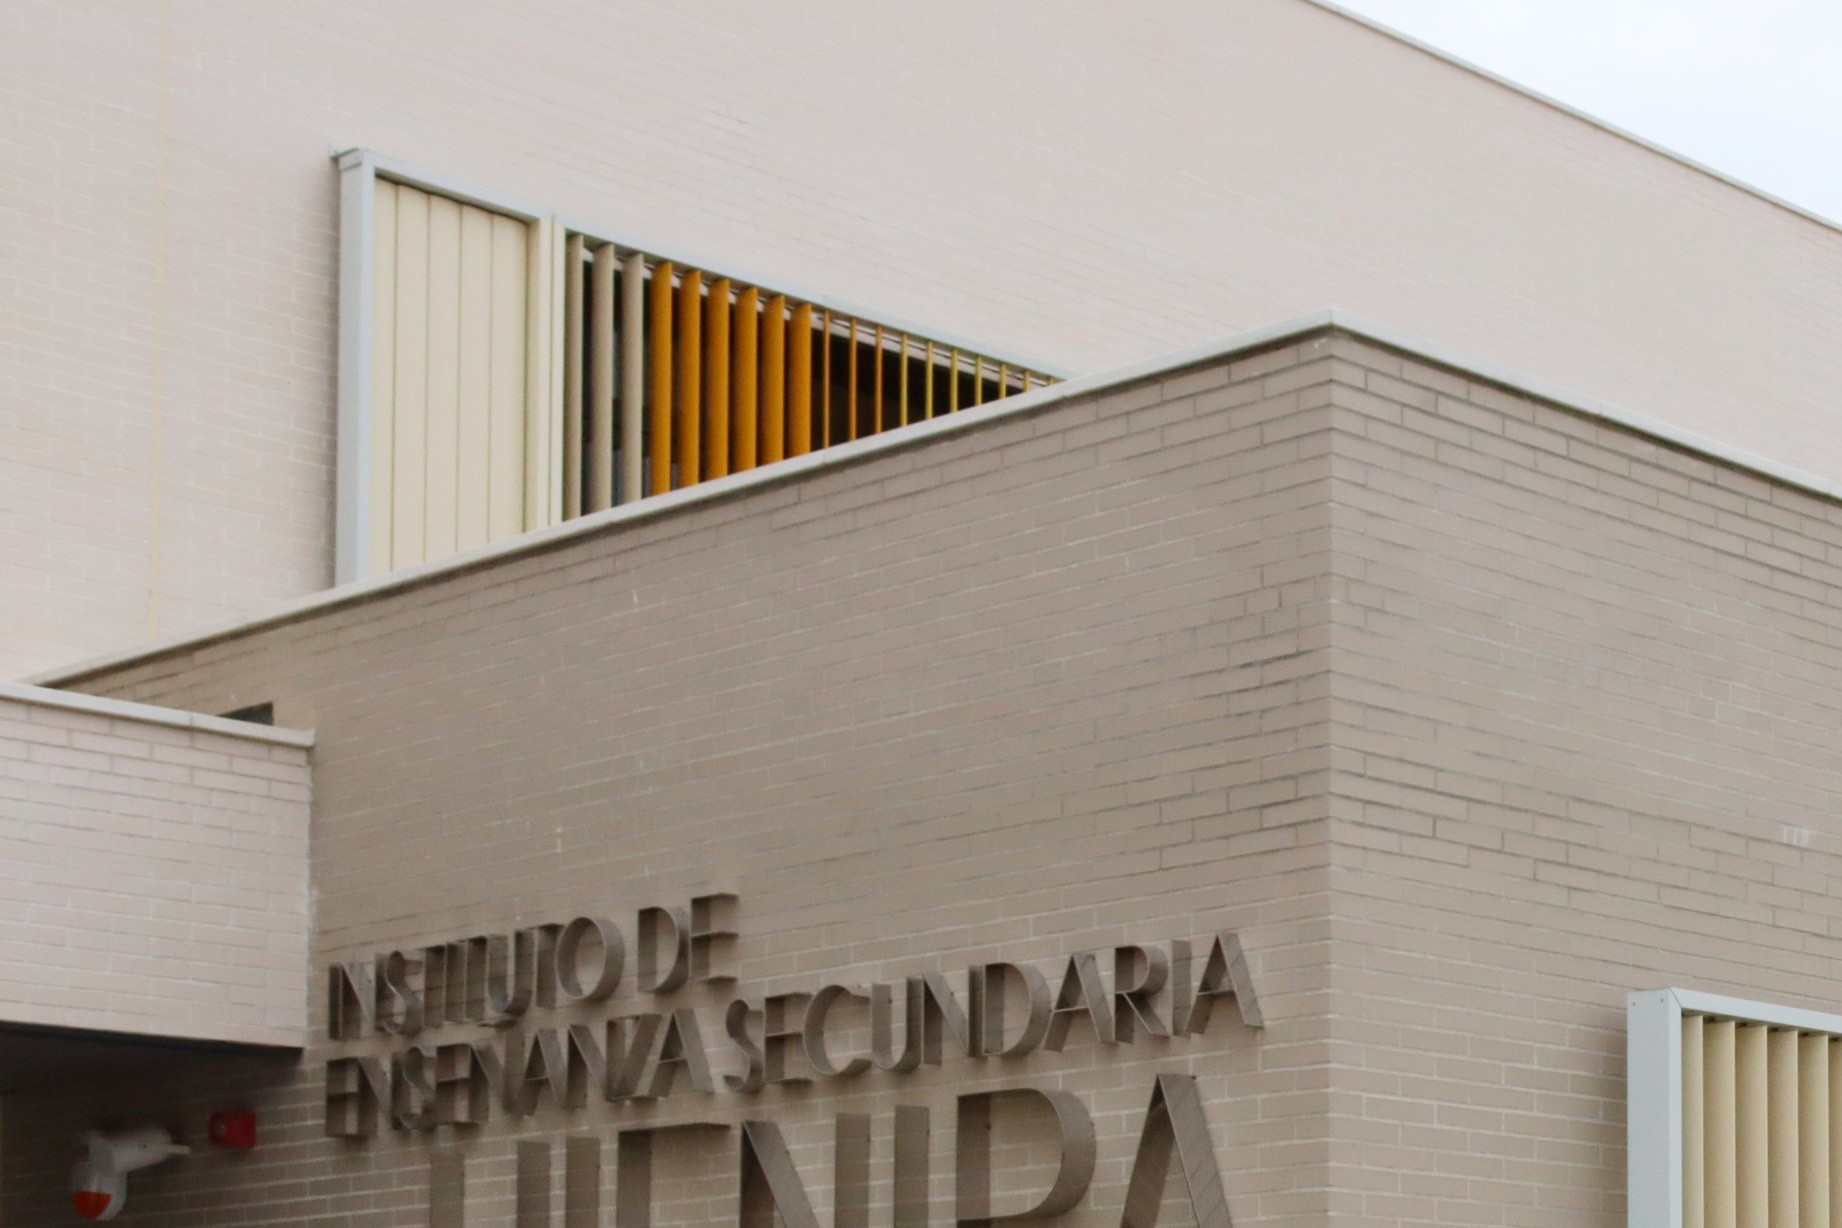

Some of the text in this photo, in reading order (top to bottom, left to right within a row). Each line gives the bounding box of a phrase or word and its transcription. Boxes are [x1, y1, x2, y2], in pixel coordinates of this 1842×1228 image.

[328, 893, 738, 1040] INSTITUTO DE
[724, 930, 1263, 1093] SECUNDARIA
